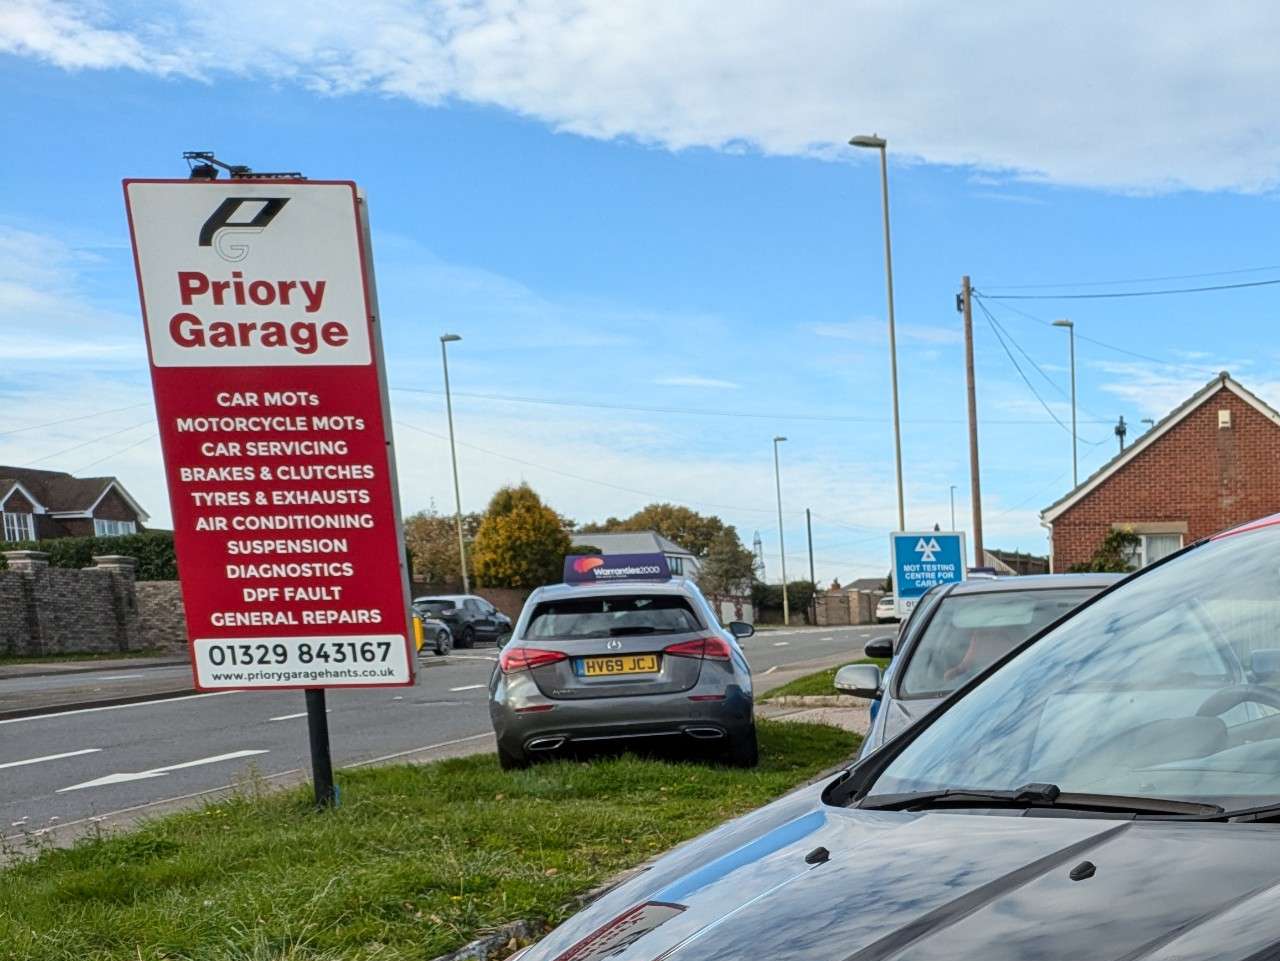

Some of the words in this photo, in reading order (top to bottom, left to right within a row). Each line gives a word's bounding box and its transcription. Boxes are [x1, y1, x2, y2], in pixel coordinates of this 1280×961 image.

[177, 271, 326, 312] Priory
[168, 312, 349, 354] Garage
[217, 392, 259, 407] CAR
[264, 391, 319, 407] MOTs
[176, 416, 308, 432] MOTORCYCLE
[312, 415, 365, 431] MOTs
[201, 442, 241, 457] CAR
[245, 441, 348, 456] SERVICING
[180, 466, 255, 482] BRAKES
[260, 467, 272, 481] &
[277, 465, 375, 481] CLUTCHES
[191, 491, 250, 506] TYRES
[255, 491, 268, 506] &
[272, 489, 370, 505] EXHAUSTS
[195, 516, 228, 531] AIR
[232, 514, 374, 530] CONDITIONING
[227, 539, 348, 554] SUSPENSION
[226, 562, 354, 578] DIAGNOSTICS
[905, 571, 936, 580] CENTRE
[938, 571, 954, 579] FOR
[923, 563, 955, 571] TESTING
[243, 587, 280, 602] DPF
[284, 586, 342, 601] FAULT
[211, 611, 298, 626] GENERAL
[303, 609, 382, 624] REPAIRS
[209, 643, 288, 666] 01329
[298, 641, 391, 664] 843167
[586, 660, 624, 673] HV69
[628, 656, 656, 671] JCJ
[212, 667, 394, 682] www.priorygaragehants.co.uk
